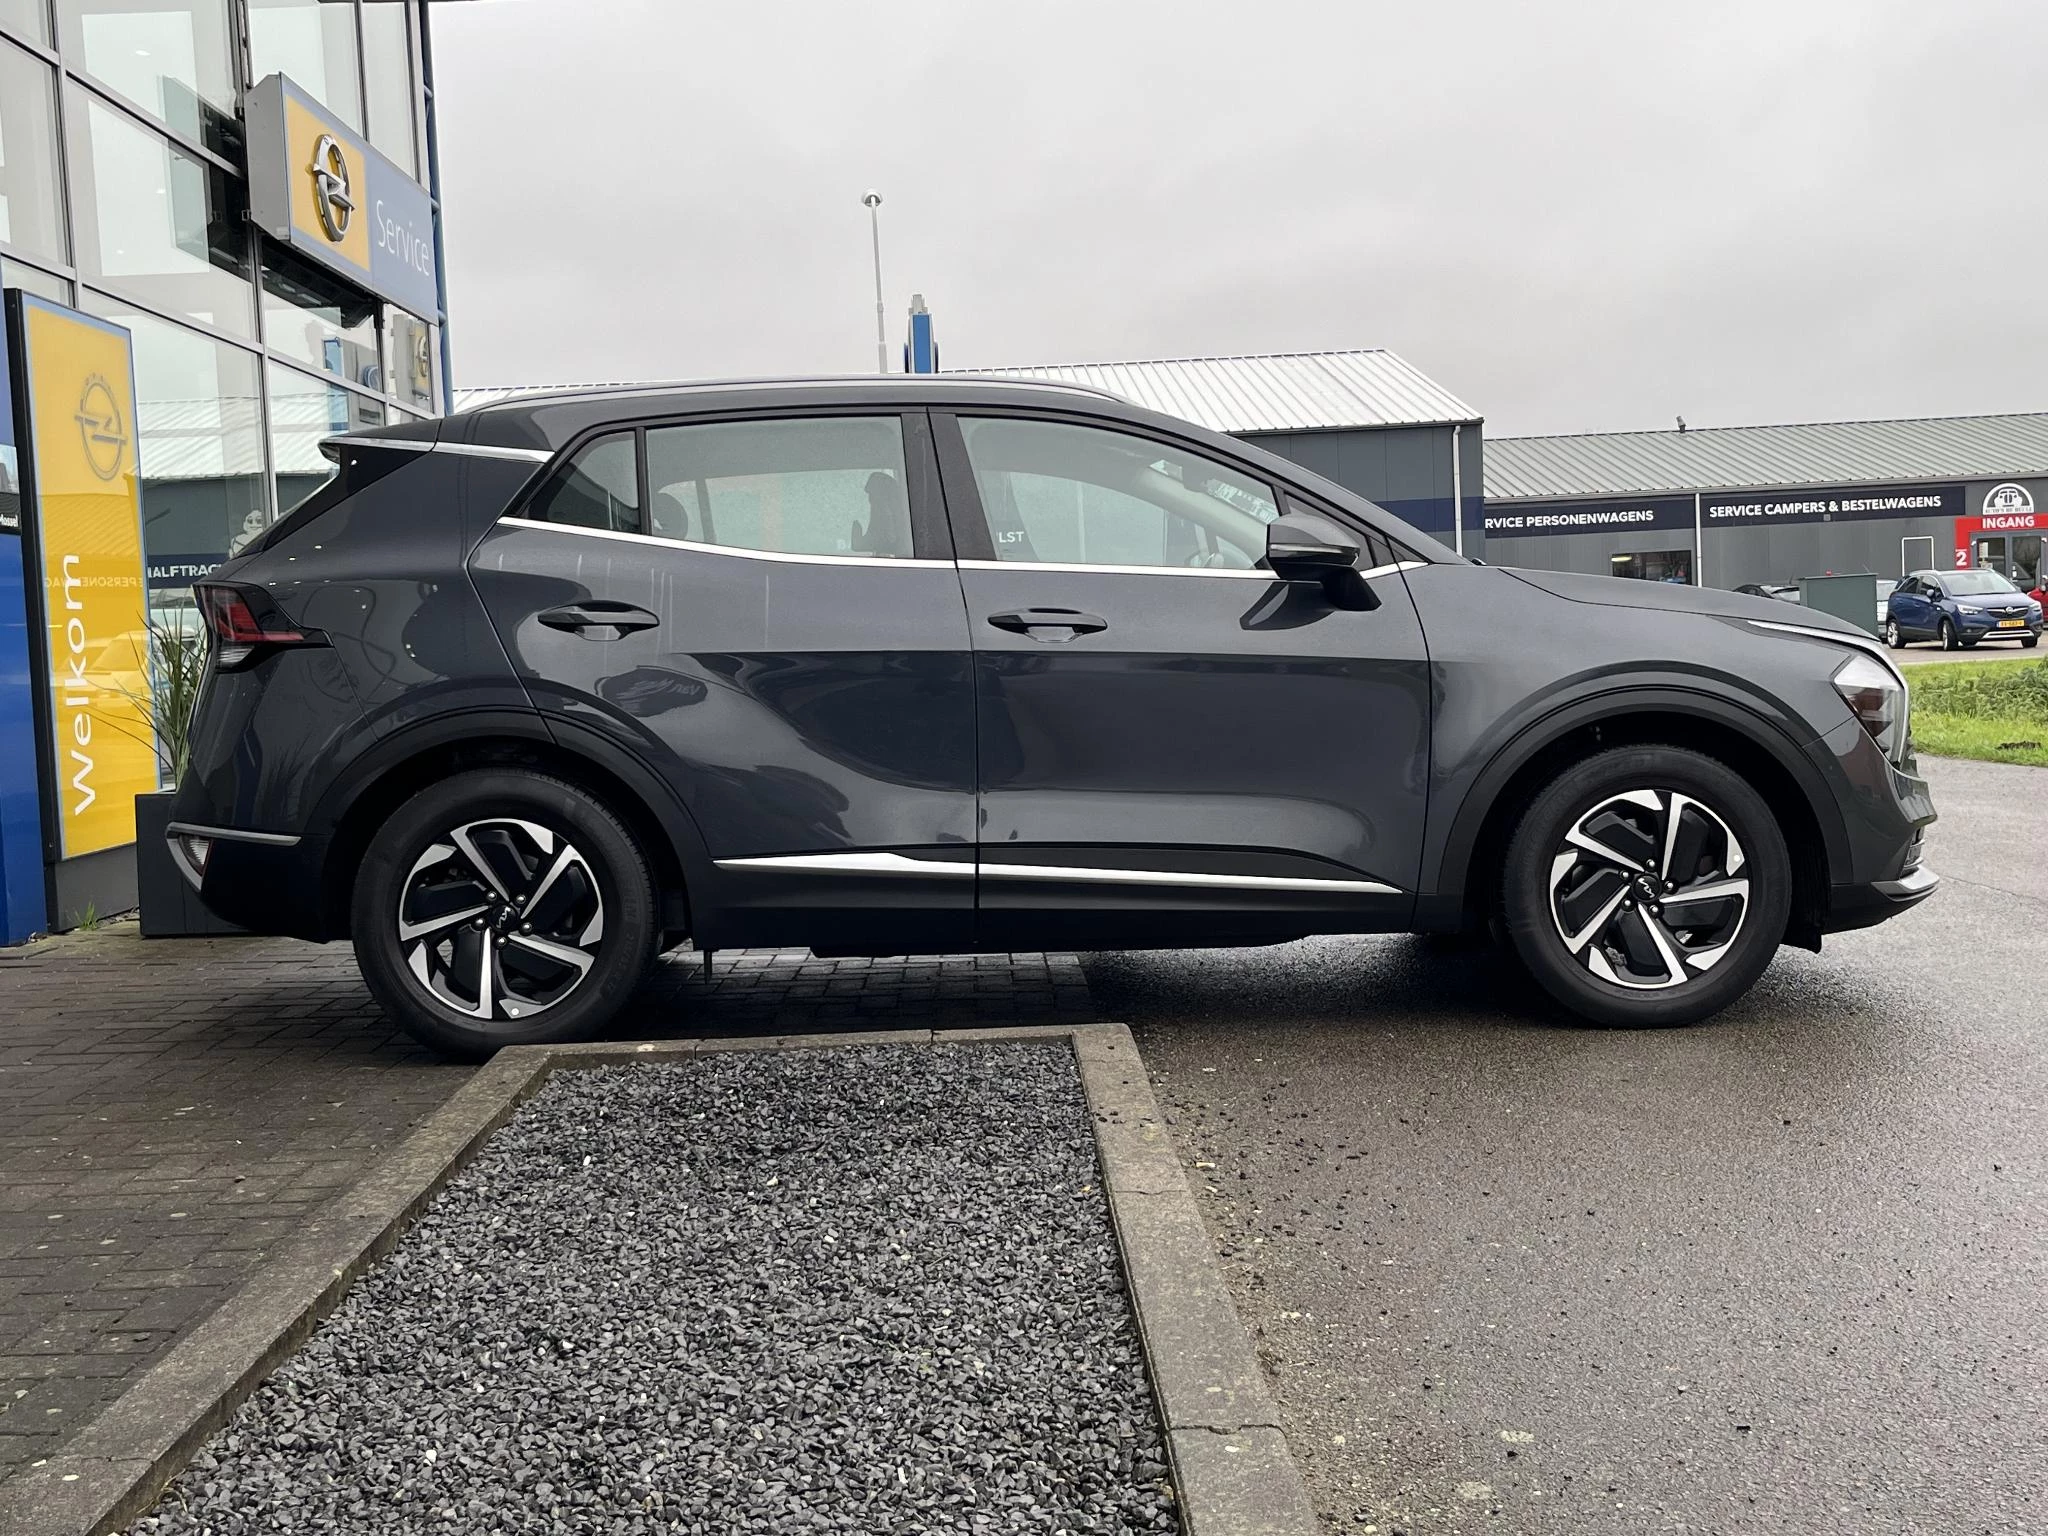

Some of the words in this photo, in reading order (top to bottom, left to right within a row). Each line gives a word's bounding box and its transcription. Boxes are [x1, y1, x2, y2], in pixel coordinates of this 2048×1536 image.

[376, 199, 430, 276] Service
[1709, 504, 1762, 518] SERVICE
[1764, 501, 1826, 515] CAMPERS
[1828, 500, 1839, 512] &
[1841, 495, 1942, 512] BESTELWAGENS
[1485, 516, 1524, 529] RVICE
[1527, 510, 1654, 528] PERSONENWAGENS
[1982, 515, 2035, 529] INGANG
[996, 531, 1025, 543] LST
[1956, 551, 1967, 566] 2
[148, 564, 222, 578] ALFTRAC
[63, 555, 95, 816] Welkom
